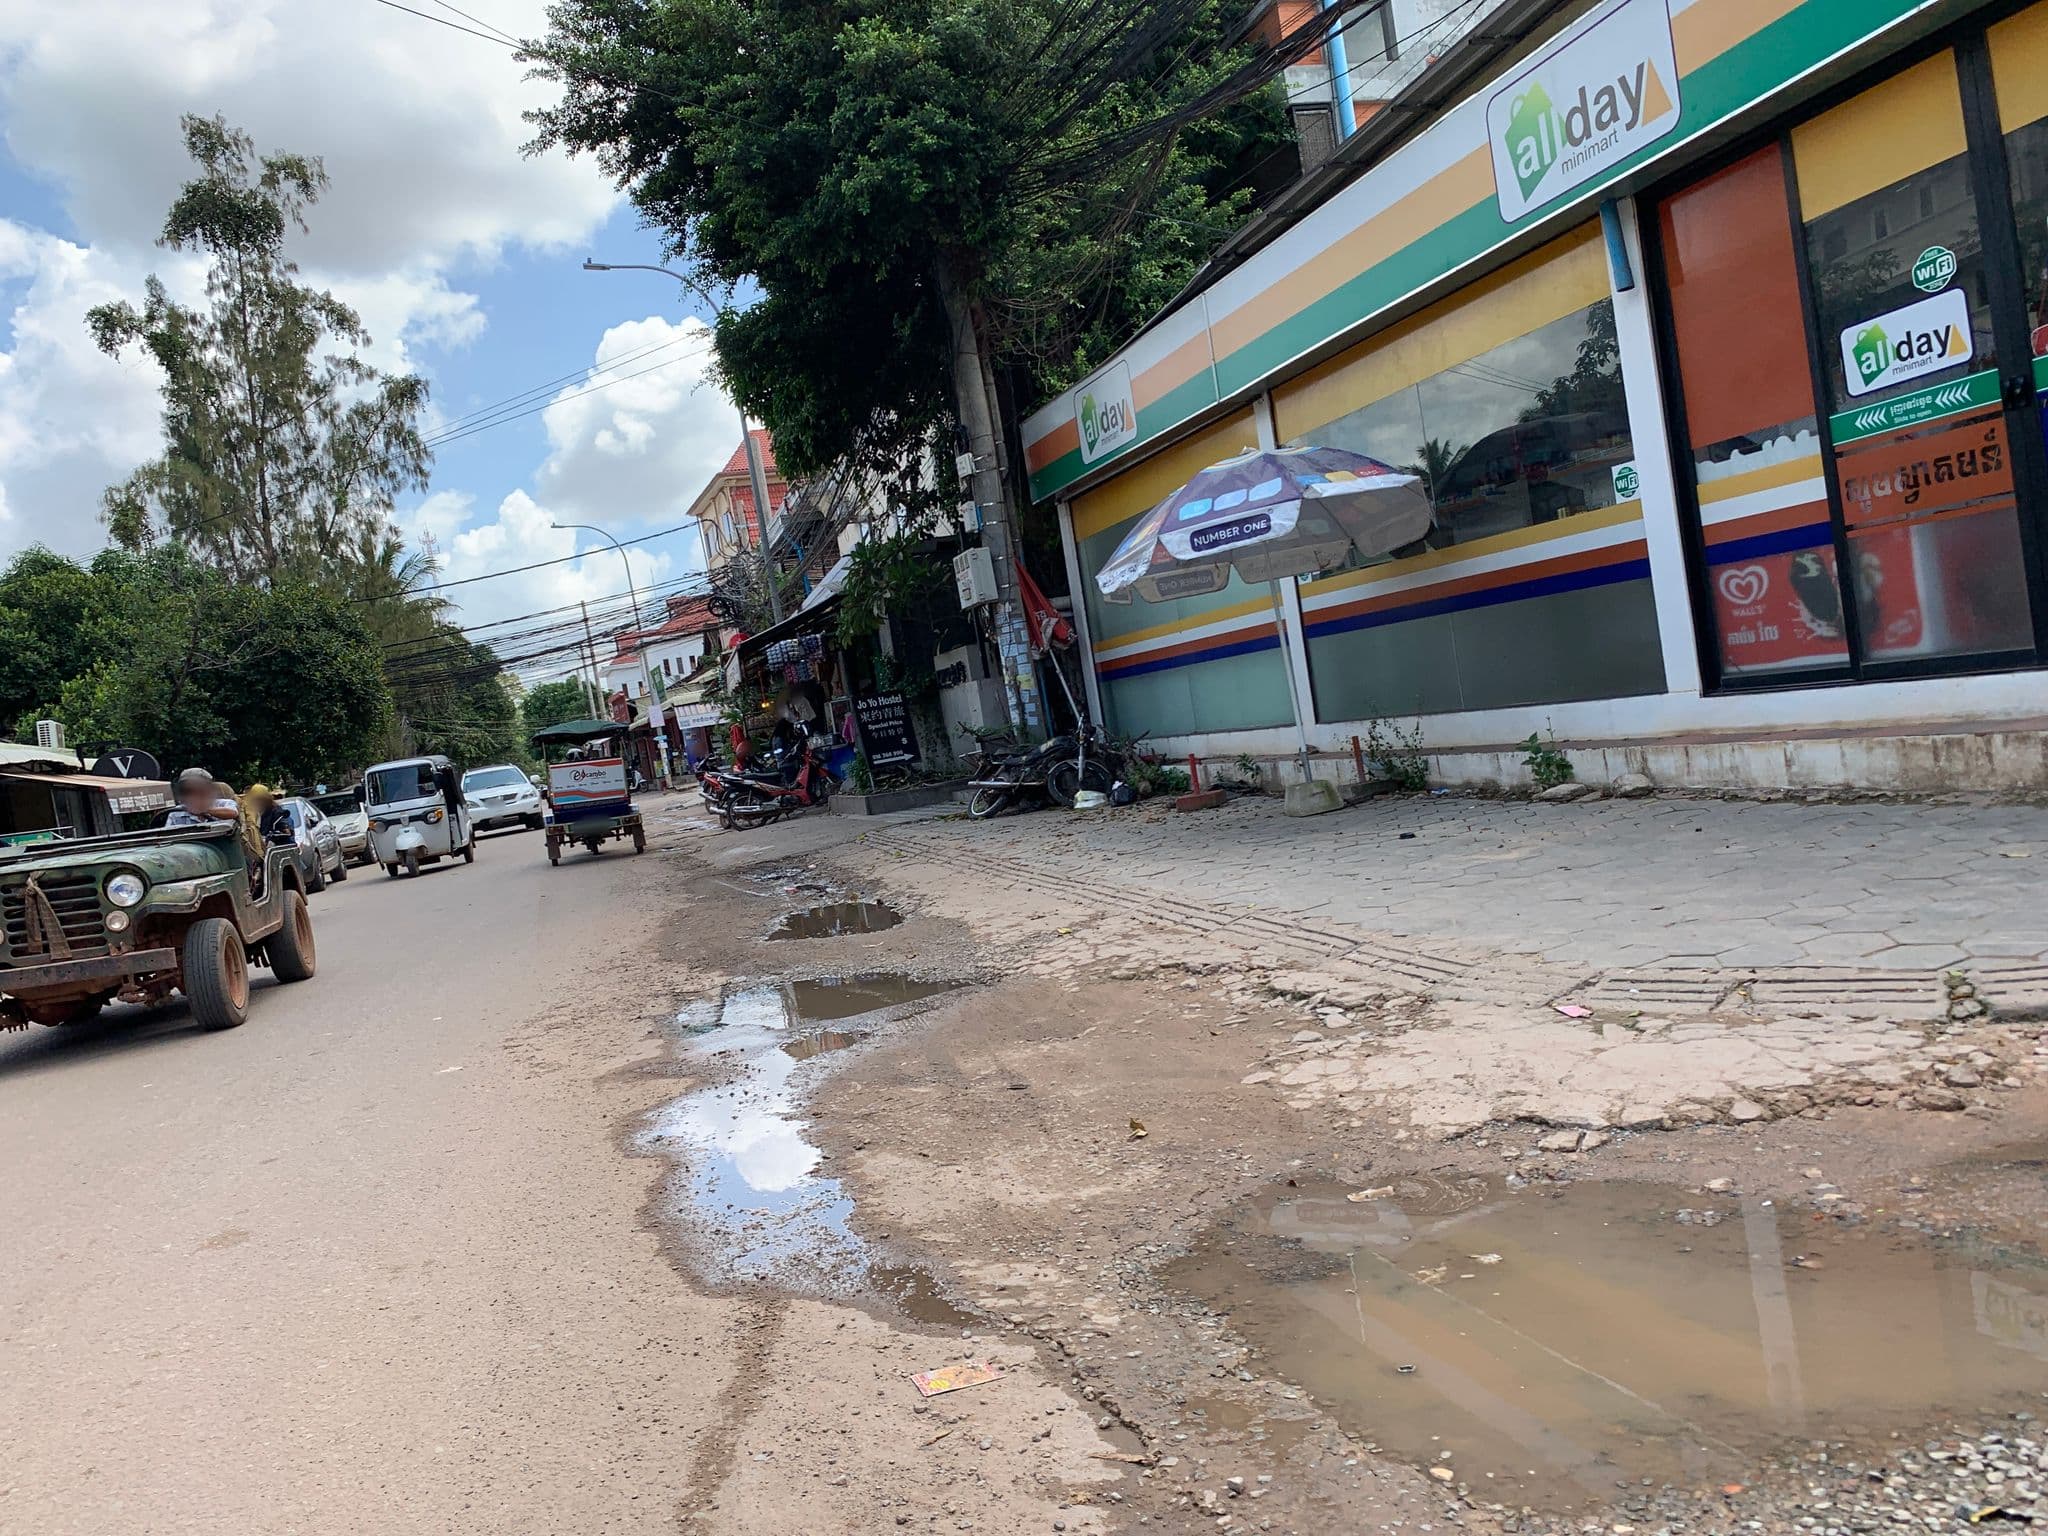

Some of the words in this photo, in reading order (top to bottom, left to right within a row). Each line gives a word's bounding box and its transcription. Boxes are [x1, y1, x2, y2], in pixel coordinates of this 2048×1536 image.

[1561, 128, 1619, 175] minimart
[1892, 356, 1933, 376] minimart
[1193, 526, 1240, 547] NUMBER
[1243, 519, 1268, 534] ONE
[857, 700, 867, 709] Jo
[867, 698, 878, 708] Yo
[878, 694, 903, 706] Hostel
[110, 755, 135, 778] V
